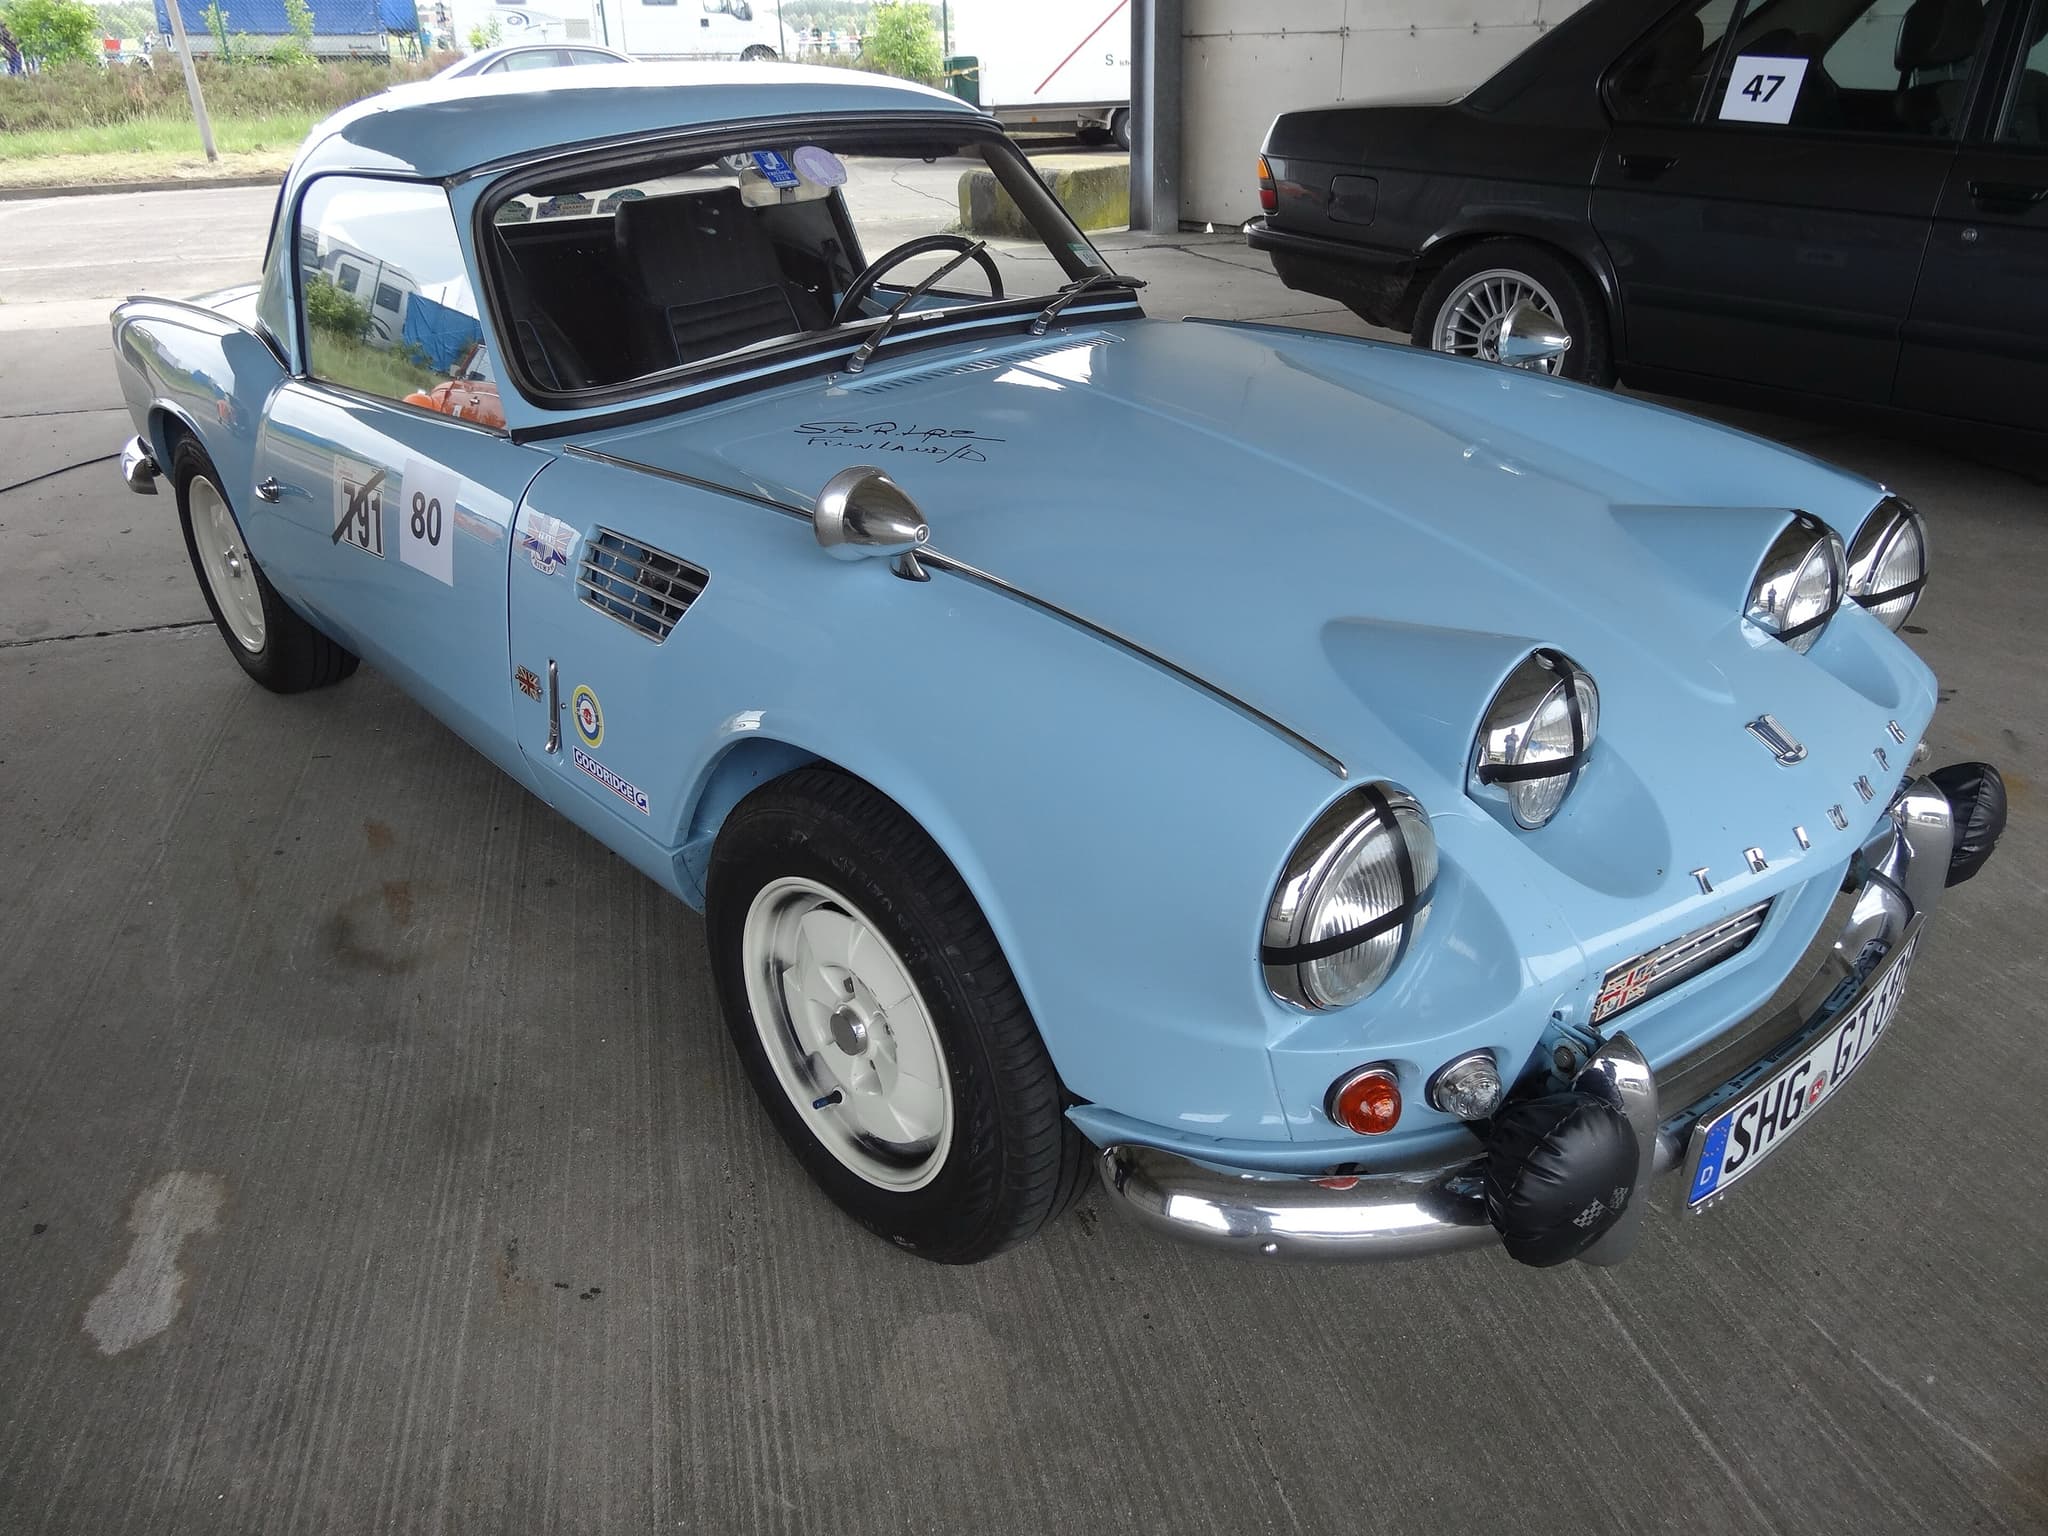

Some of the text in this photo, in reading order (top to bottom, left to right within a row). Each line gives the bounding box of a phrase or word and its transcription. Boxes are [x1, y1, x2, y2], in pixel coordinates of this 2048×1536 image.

[1741, 74, 1786, 103] 47
[343, 482, 383, 555] 791
[410, 491, 442, 546] 80
[575, 750, 635, 801] GOODRIDGE
[1689, 719, 1907, 895] TRIUMPH
[1724, 1060, 1811, 1174] SHG
[1830, 995, 1874, 1087] GT
[1700, 1165, 1714, 1186] D
